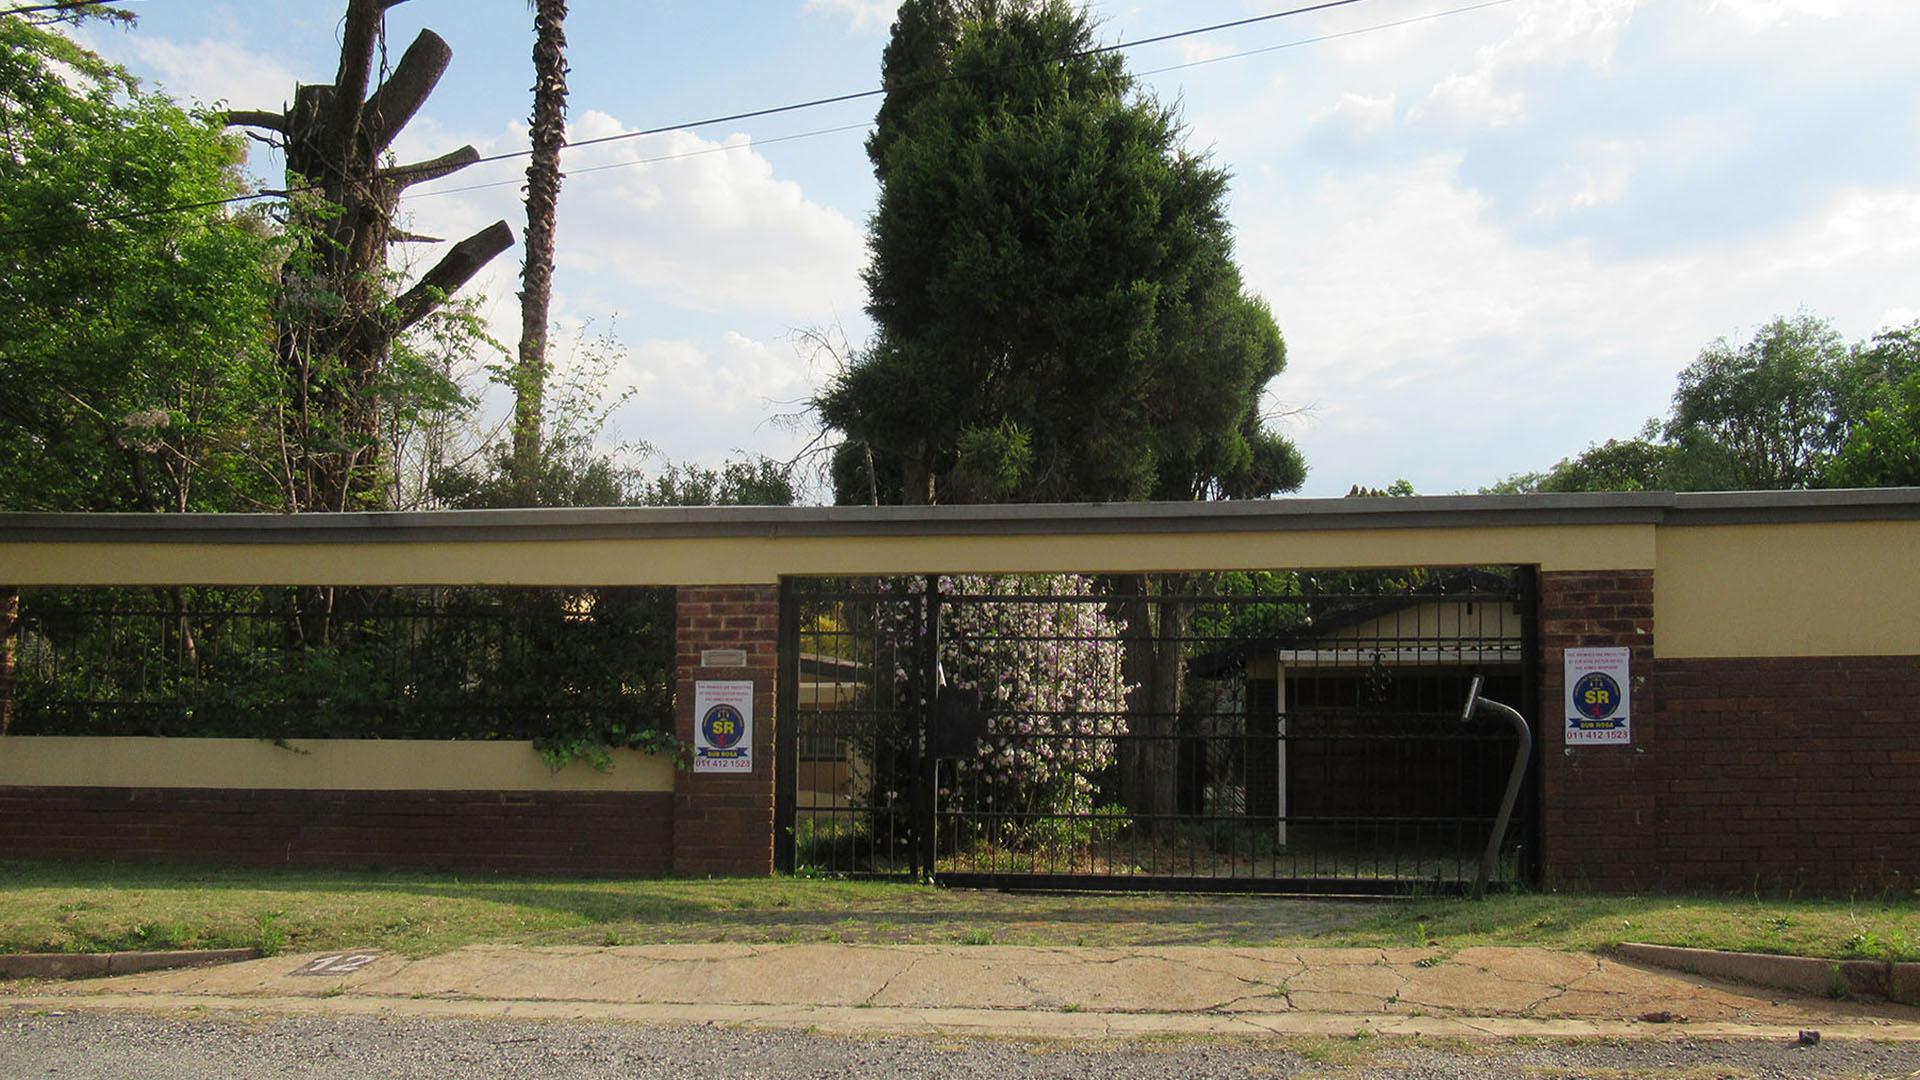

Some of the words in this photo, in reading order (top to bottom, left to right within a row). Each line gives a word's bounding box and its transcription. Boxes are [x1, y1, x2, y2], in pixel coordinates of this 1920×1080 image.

[1585, 690, 1609, 704] SR
[712, 721, 735, 734] SR
[1567, 731, 1583, 739] 011
[1586, 731, 1603, 739] 412
[1607, 731, 1628, 739] 1523
[309, 955, 378, 971] 12
